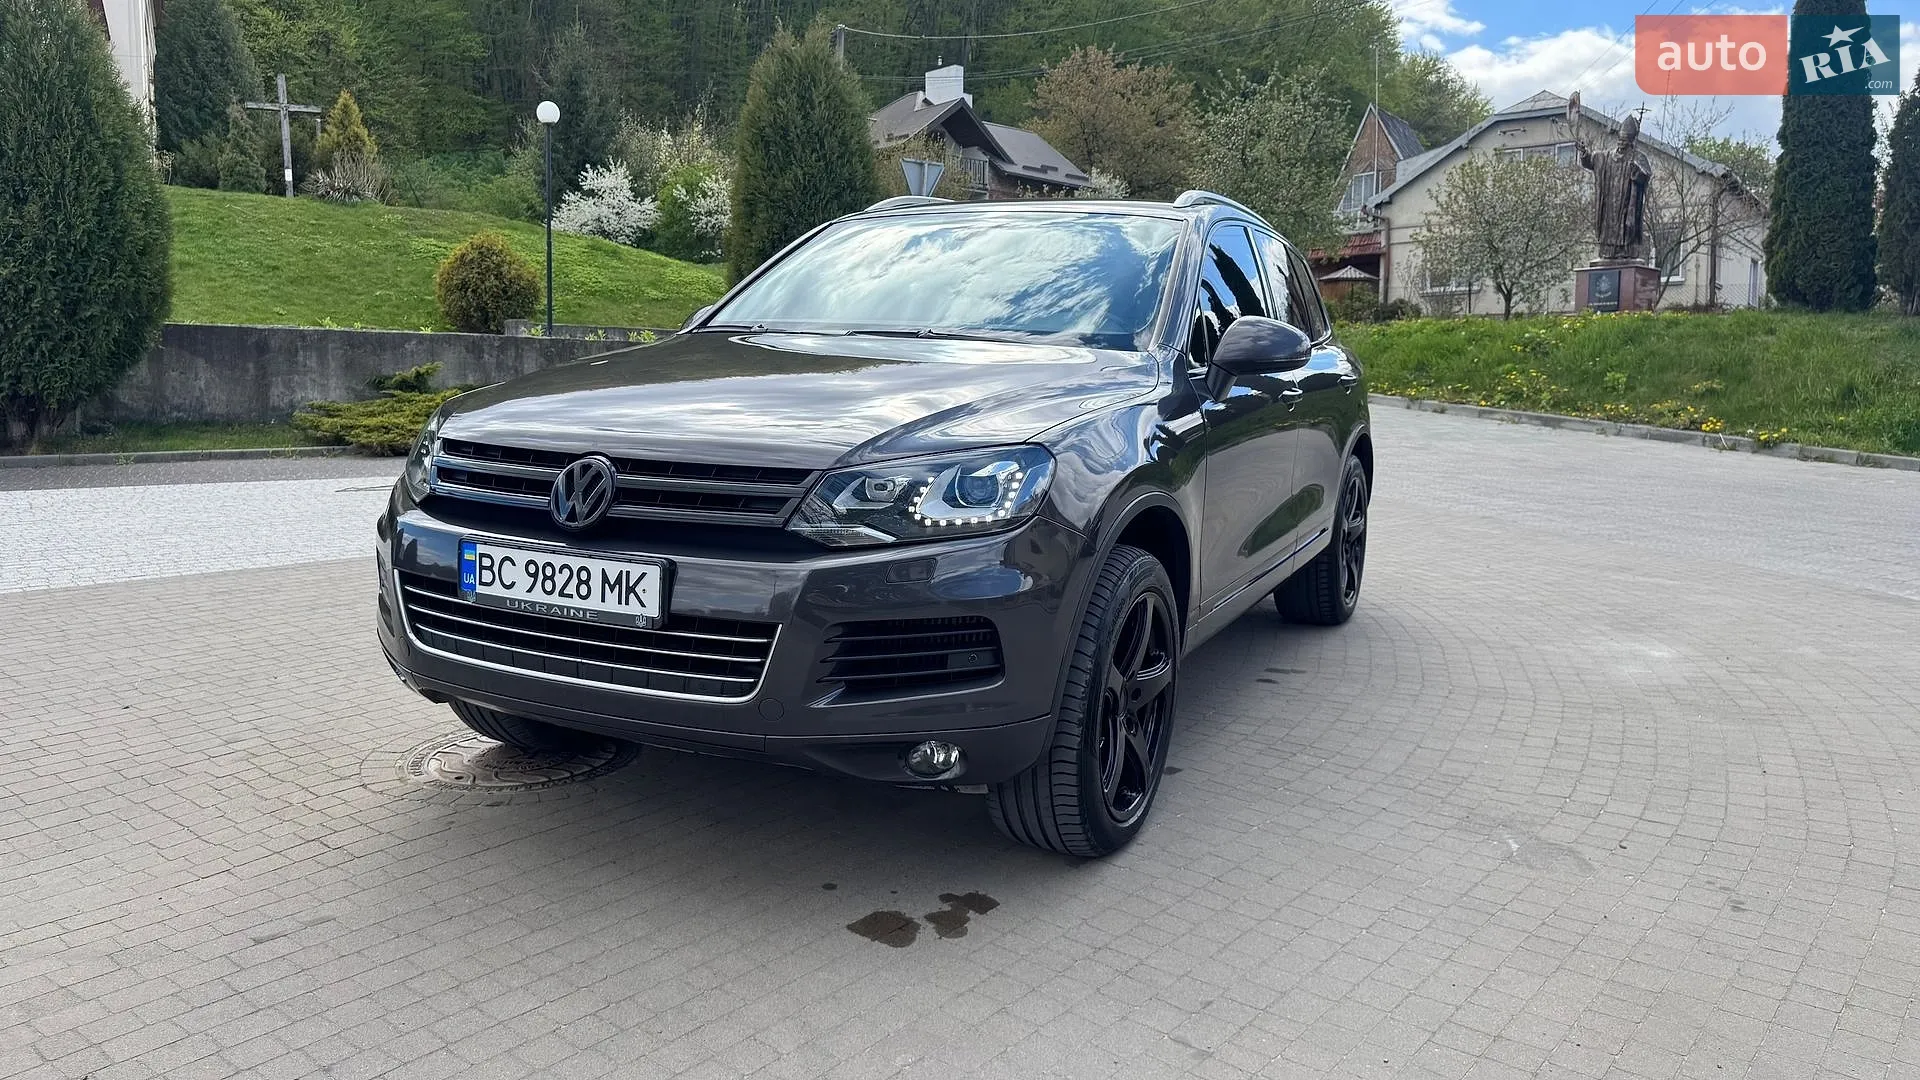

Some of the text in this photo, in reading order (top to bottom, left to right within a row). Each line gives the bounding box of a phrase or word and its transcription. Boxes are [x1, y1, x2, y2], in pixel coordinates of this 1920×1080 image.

[463, 572, 476, 584] UA
[478, 552, 648, 608] BC 9828 MK
[506, 598, 599, 620] UKRAINE
